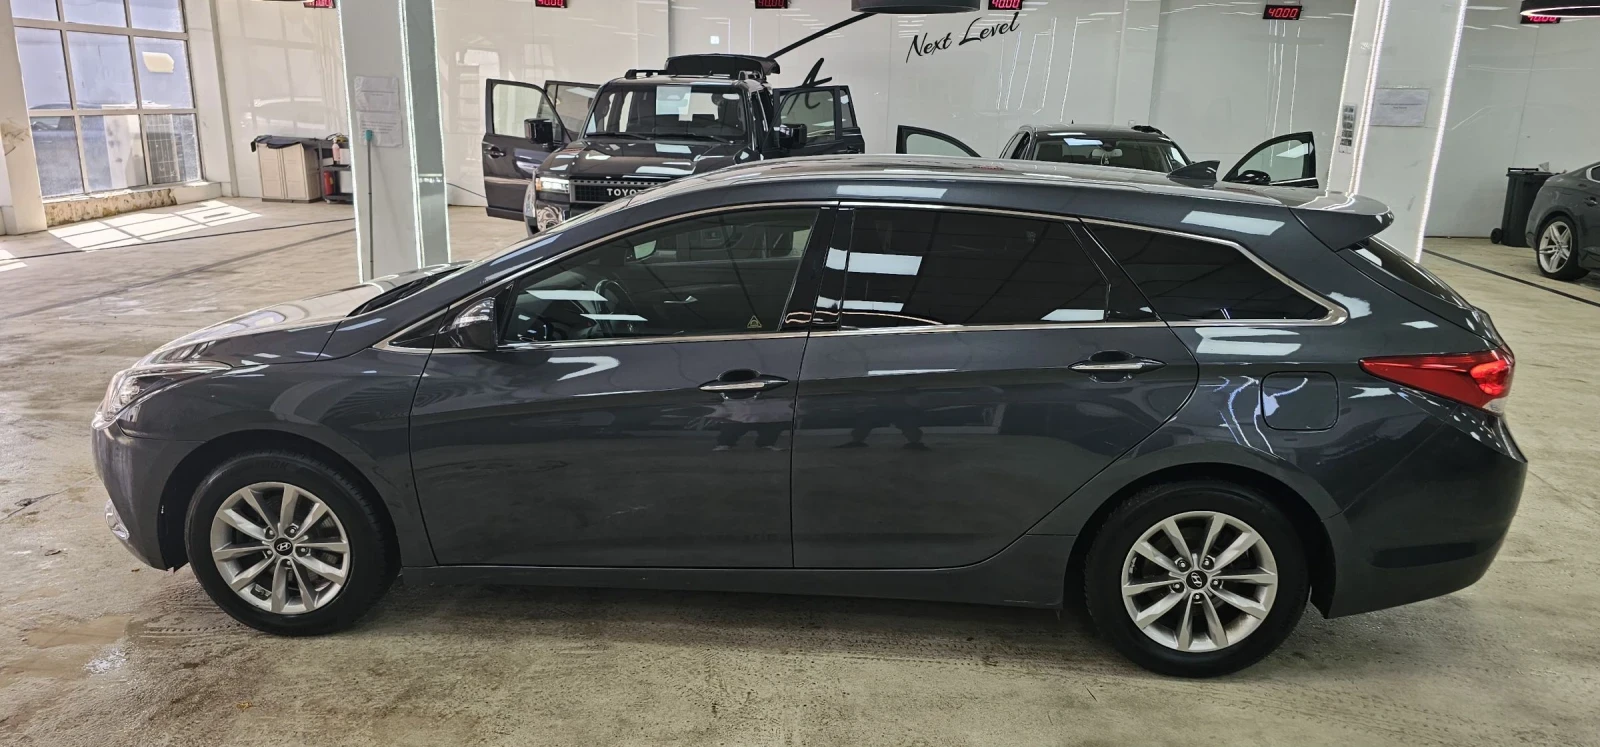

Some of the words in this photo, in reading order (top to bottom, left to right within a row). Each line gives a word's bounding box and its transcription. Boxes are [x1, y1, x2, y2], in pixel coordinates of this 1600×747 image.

[1268, 7, 1298, 18] 40.00
[905, 32, 953, 64] Next
[958, 11, 1020, 46] Level
[607, 188, 646, 196] TOYO
